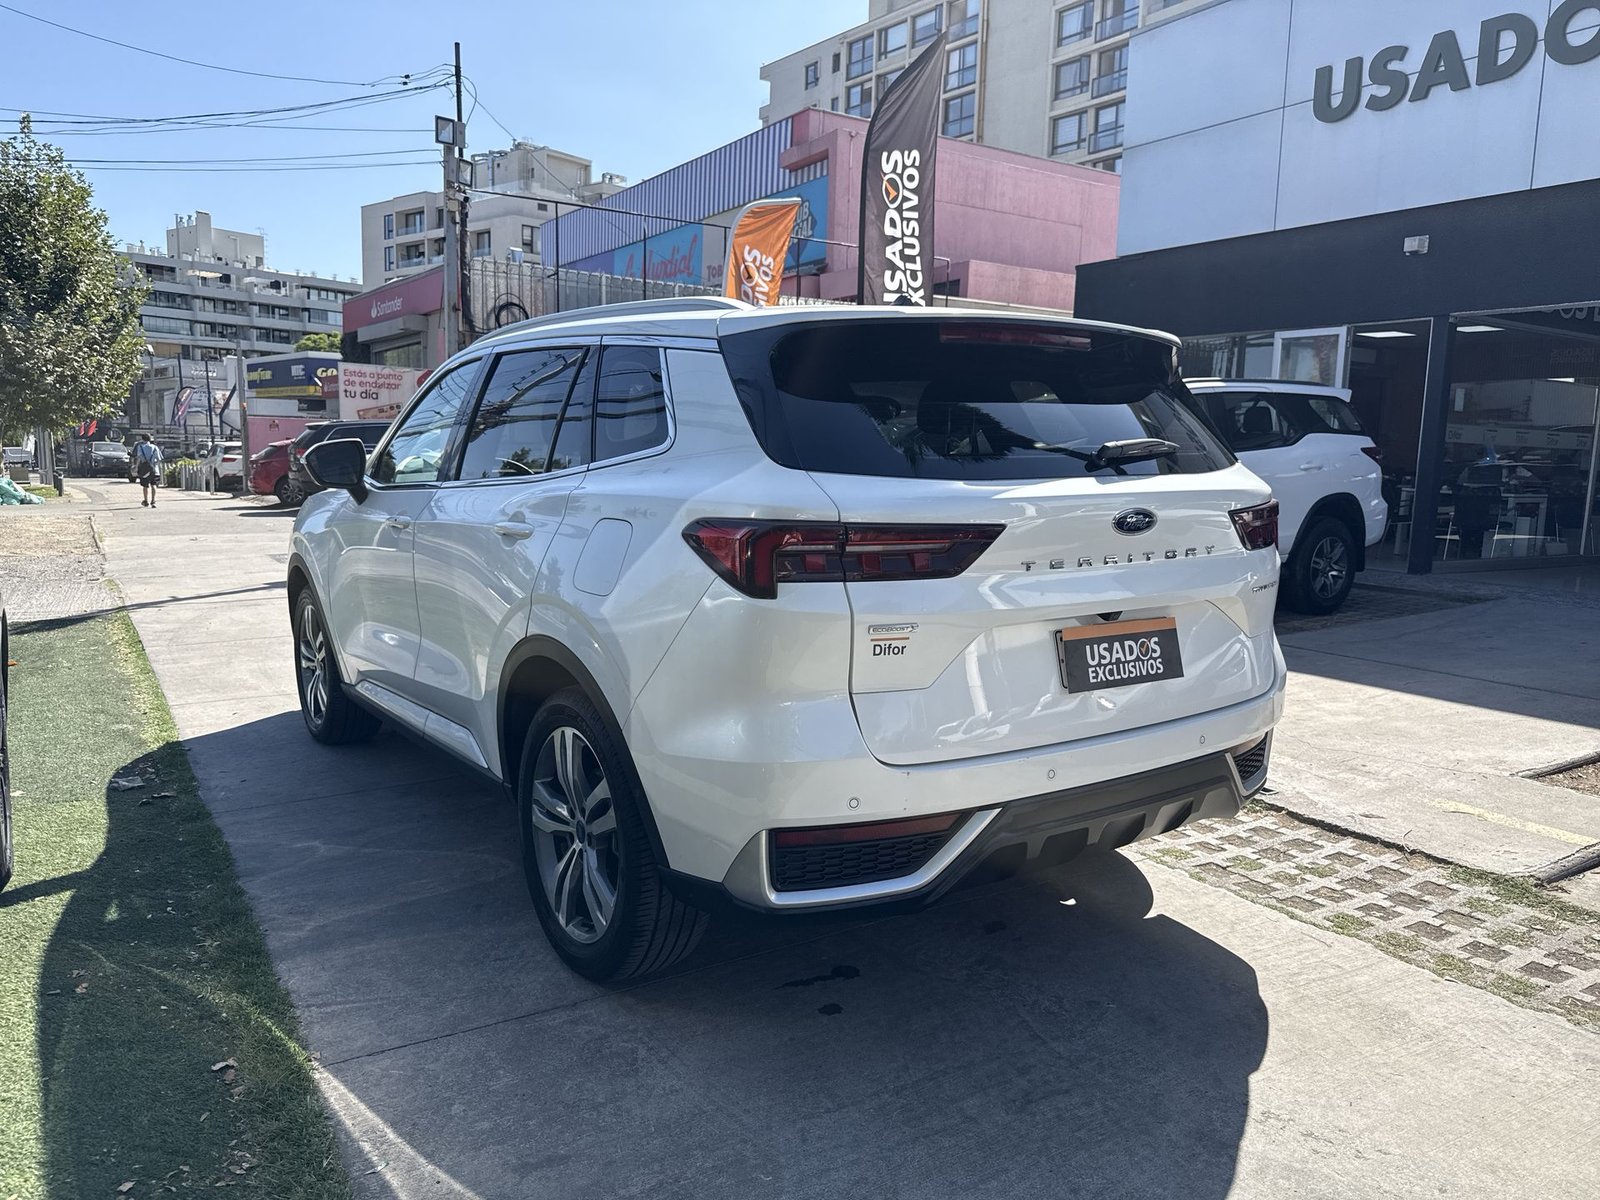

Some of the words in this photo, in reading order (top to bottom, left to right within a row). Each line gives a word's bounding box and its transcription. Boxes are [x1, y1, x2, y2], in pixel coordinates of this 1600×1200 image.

[1313, 0, 1600, 123] USADO
[903, 149, 926, 307] XCLUSIVOS
[741, 245, 762, 304] DOS
[377, 296, 403, 317] Santander
[343, 378, 357, 387] de
[377, 372, 403, 381] punto
[343, 388, 357, 399] tu
[1020, 545, 1216, 572] TERRITORY
[872, 643, 907, 657] Difor
[1085, 636, 1161, 666] USADOS
[1088, 658, 1164, 684] EXCLUSIVOS
